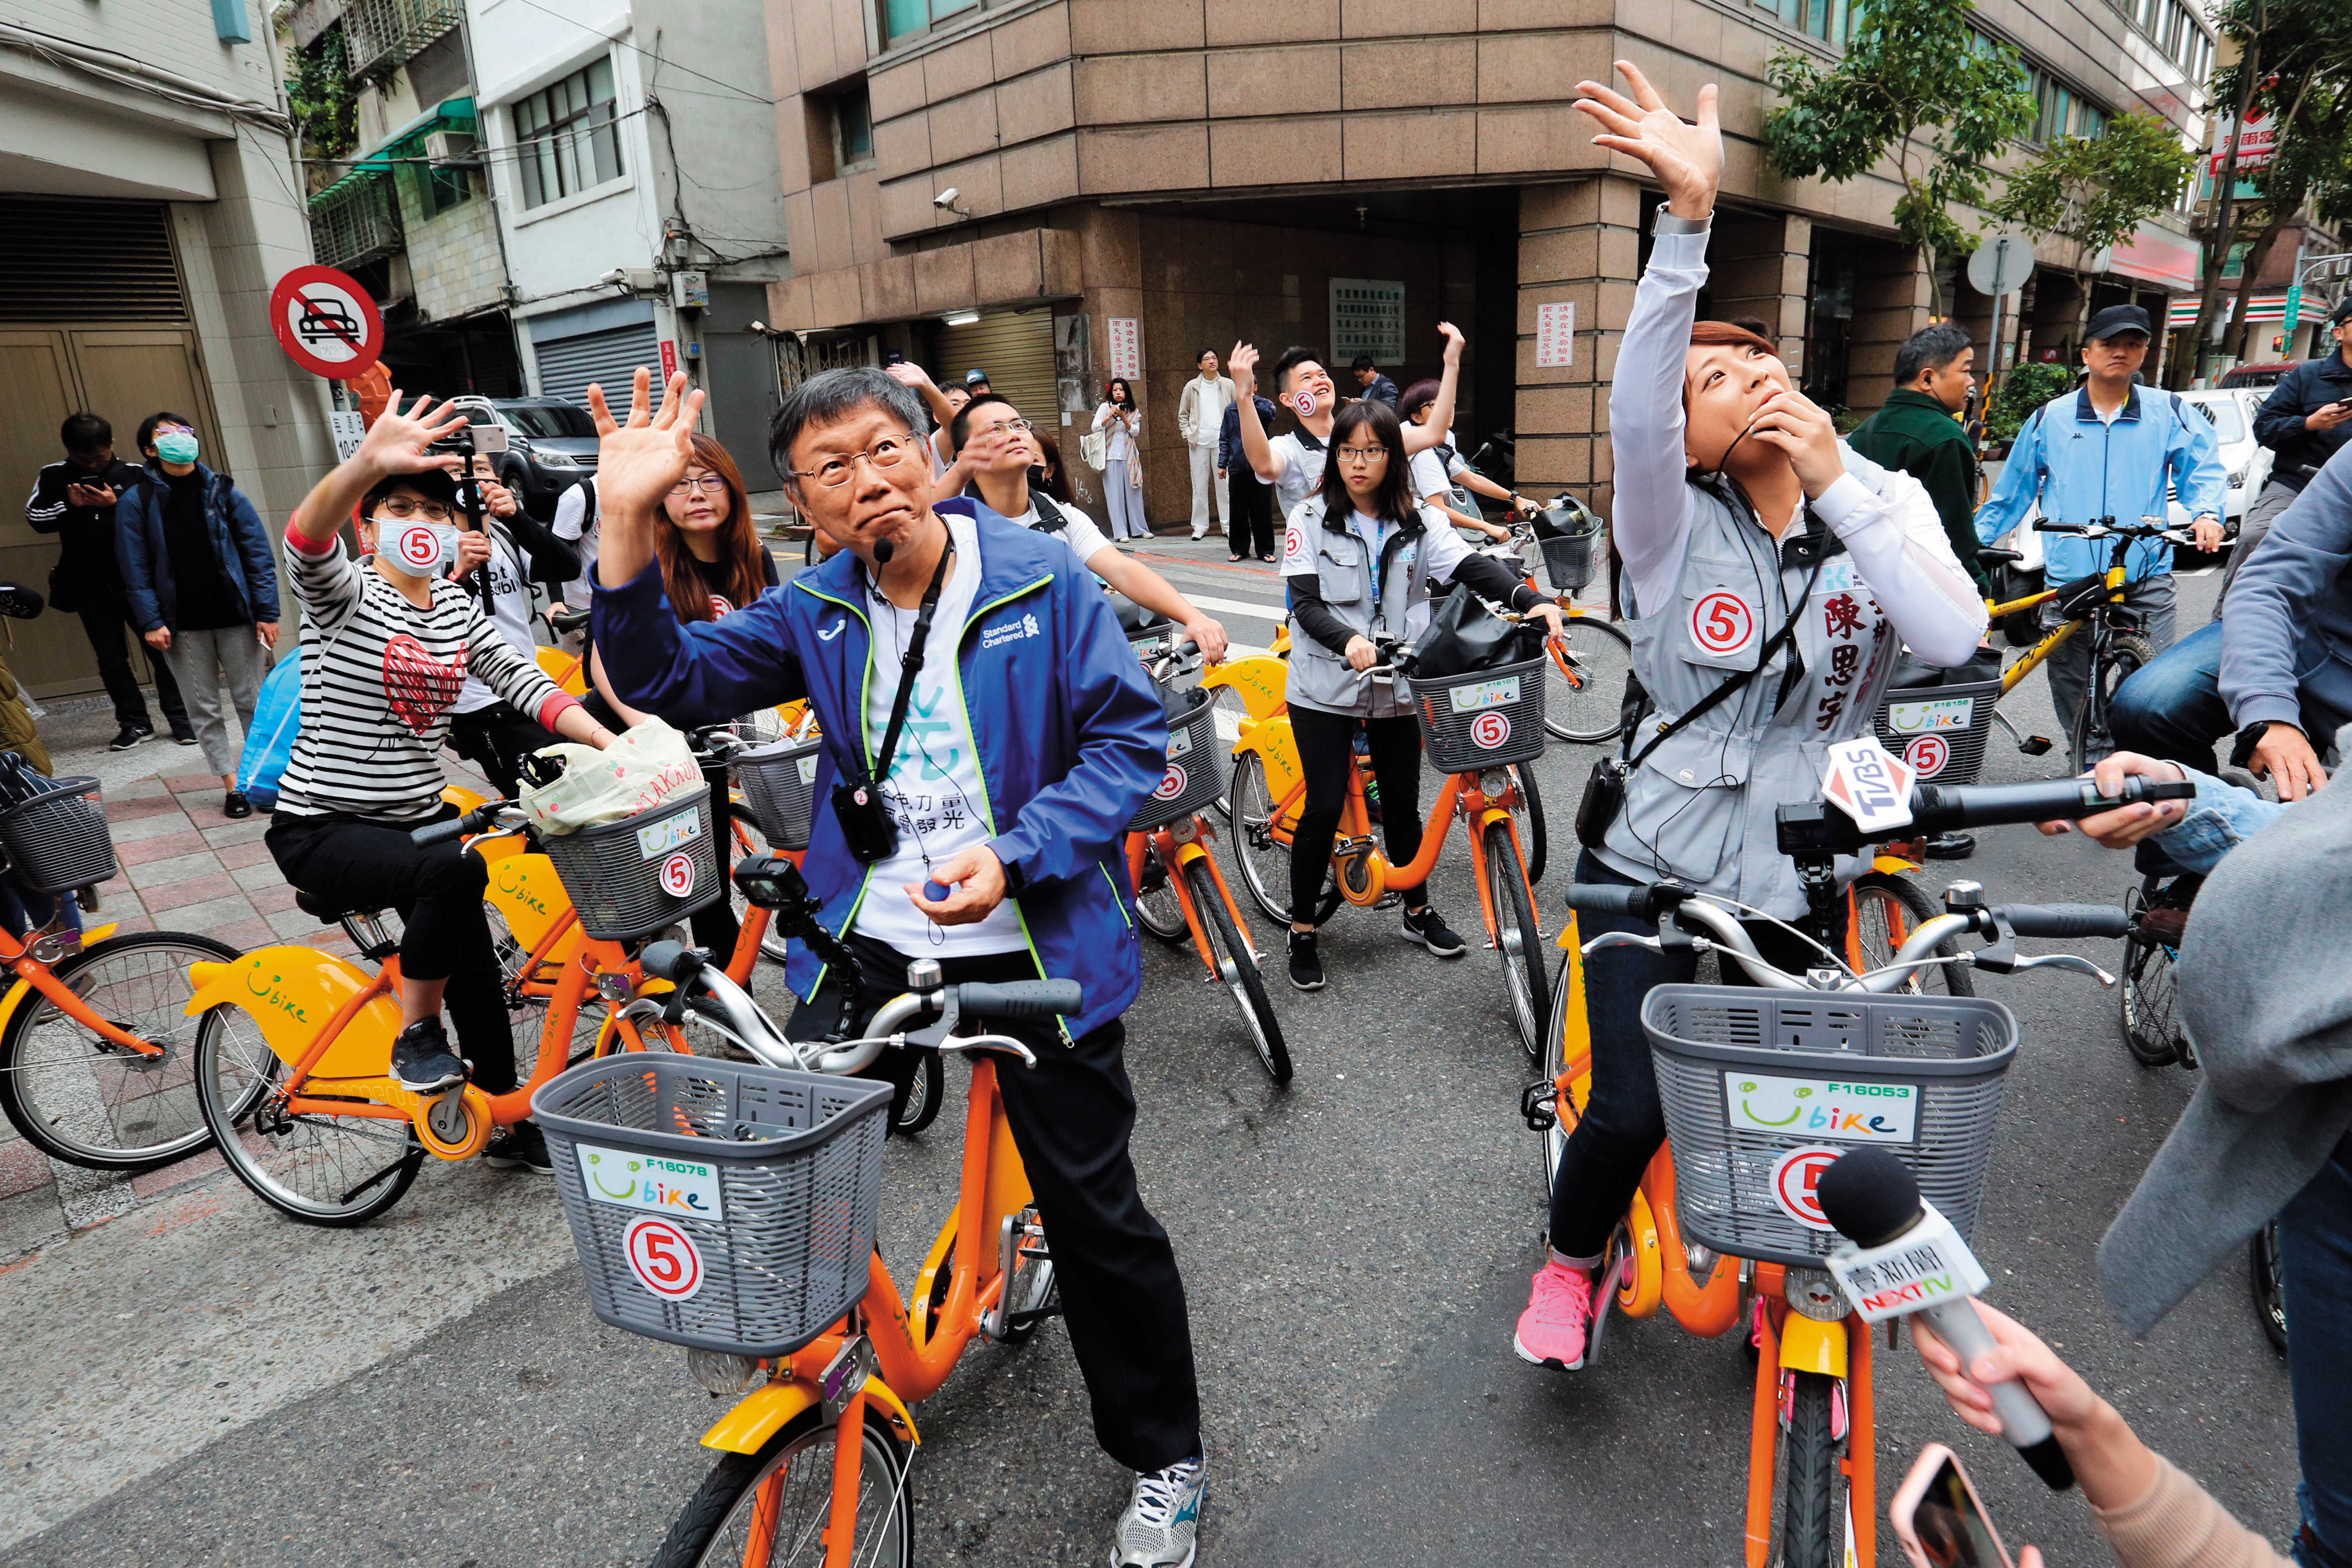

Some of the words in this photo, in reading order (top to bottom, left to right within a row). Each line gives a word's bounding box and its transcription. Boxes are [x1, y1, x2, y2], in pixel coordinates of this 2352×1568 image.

[983, 620, 1021, 638] Standard
[983, 629, 1024, 648] Chartered
[1816, 594, 1867, 731] 陳思宇
[1846, 749, 1896, 817] TVBS
[1828, 1083, 1909, 1098] F16053
[646, 1149, 708, 1177] F16078
